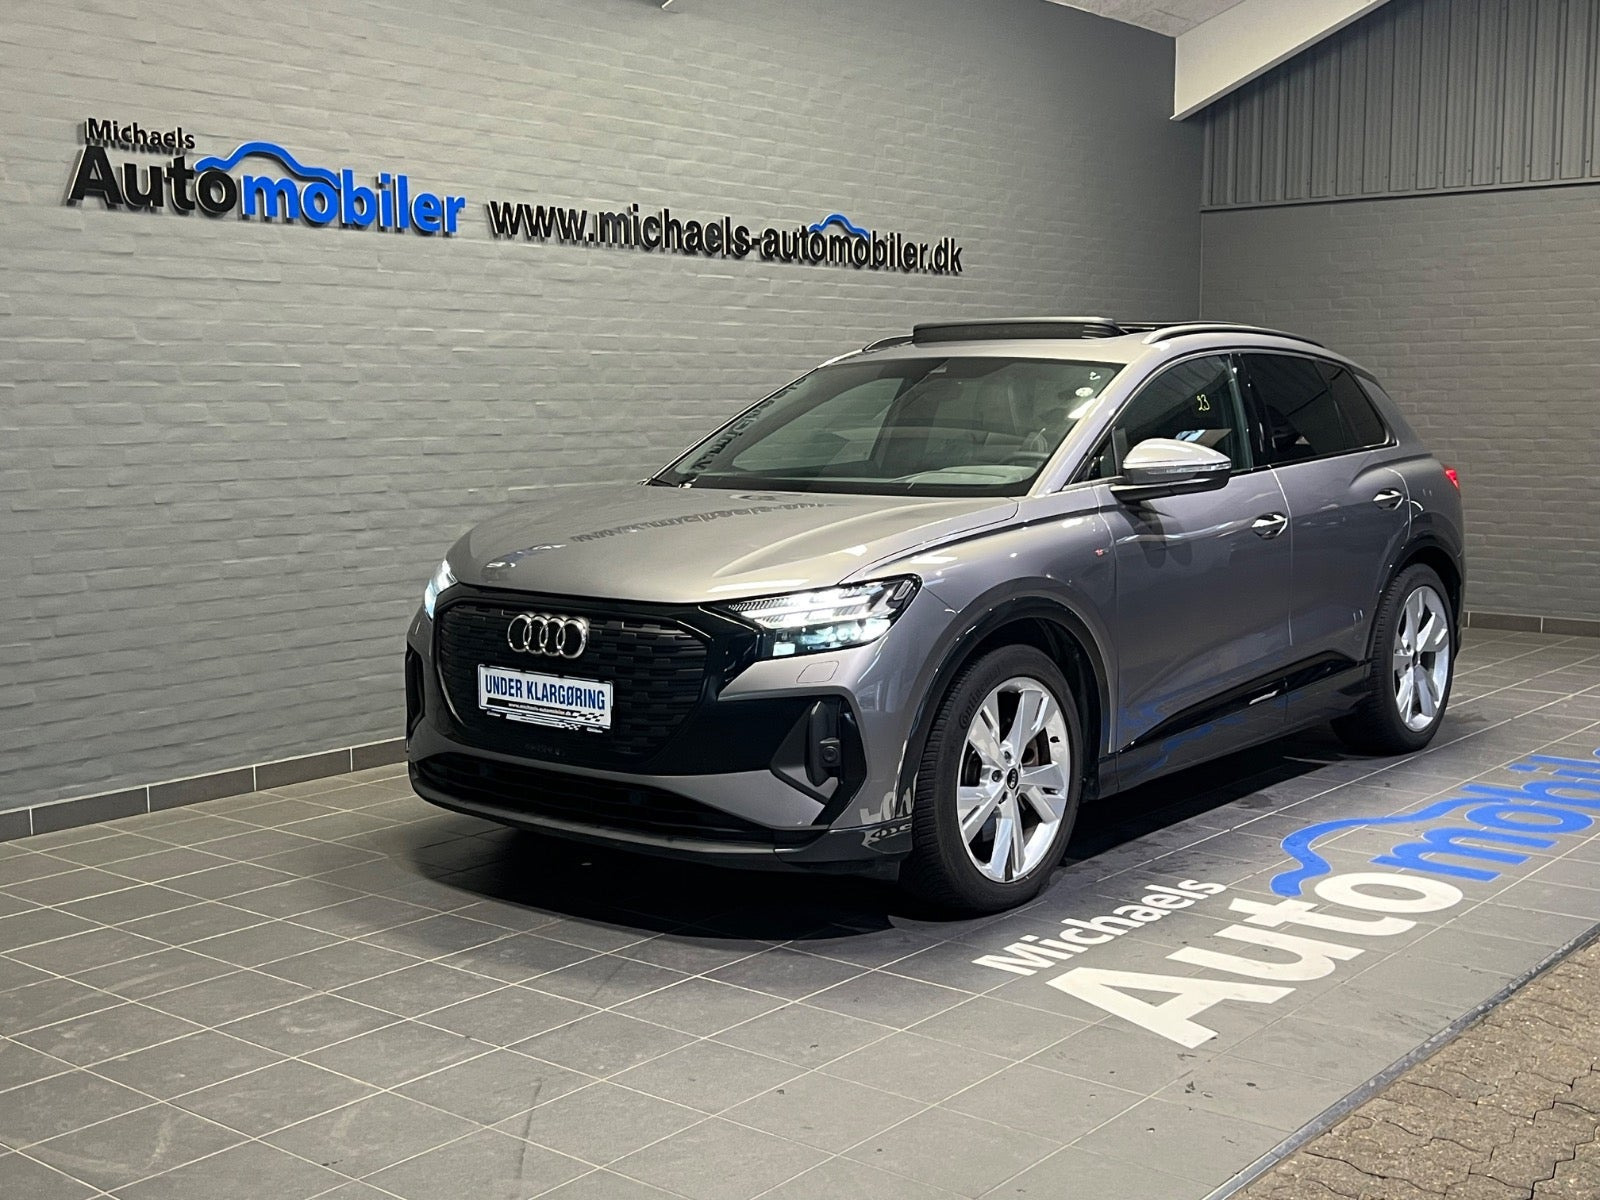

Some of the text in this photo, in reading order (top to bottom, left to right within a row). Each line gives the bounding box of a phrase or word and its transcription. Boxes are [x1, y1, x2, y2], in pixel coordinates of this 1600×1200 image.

[85, 117, 195, 149] Michaels
[67, 145, 465, 233] Automobiler
[488, 200, 962, 273] www.michaels-automobiler.dk
[485, 674, 522, 698] UNDER
[527, 680, 605, 710] KLARGØRING
[971, 875, 1227, 976] Michaels
[1045, 748, 1600, 1049] Automobil
